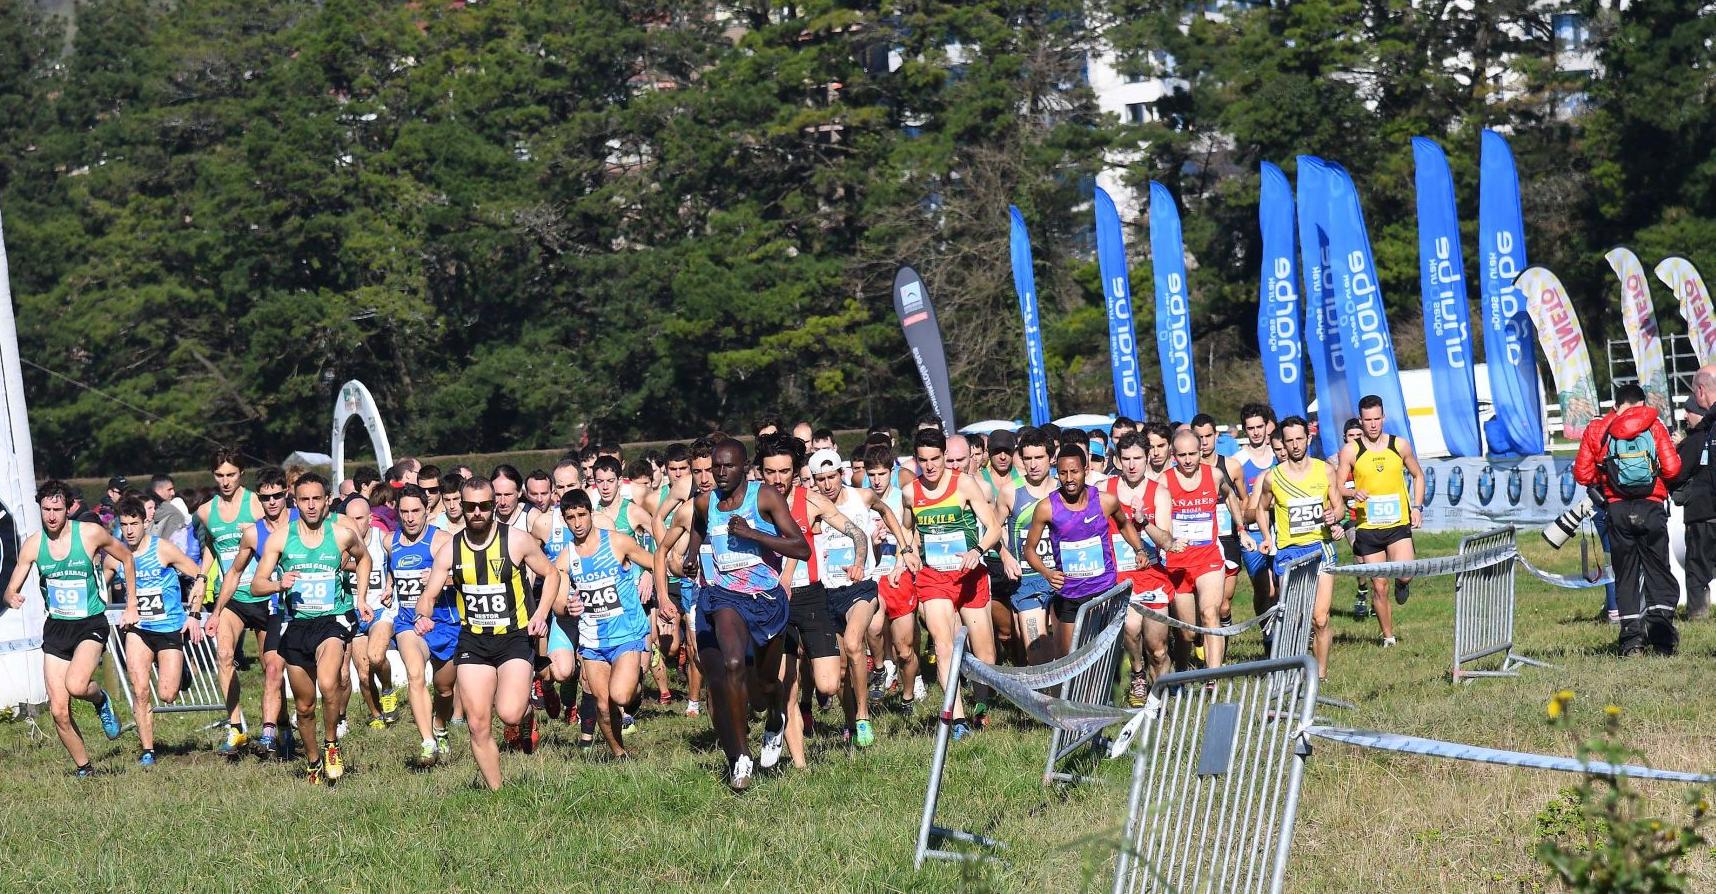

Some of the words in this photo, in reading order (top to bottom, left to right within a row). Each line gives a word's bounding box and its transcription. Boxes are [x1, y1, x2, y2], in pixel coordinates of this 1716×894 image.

[1171, 497, 1215, 507] AÑARES
[1289, 503, 1323, 522] 250
[1373, 502, 1395, 517] 50
[917, 513, 957, 525] BIKILA
[550, 544, 564, 552] TOL
[844, 548, 852, 560] 4
[941, 543, 950, 554] 7
[1078, 550, 1087, 561] 2
[609, 566, 619, 576] CF
[1068, 559, 1099, 572] HAJI
[152, 568, 162, 577] CF
[349, 571, 381, 585] 25
[301, 582, 327, 598] 28
[397, 579, 424, 595] 22
[55, 589, 79, 604] 69
[137, 594, 163, 611] 24
[581, 587, 618, 607] 246
[465, 594, 507, 613] 218
